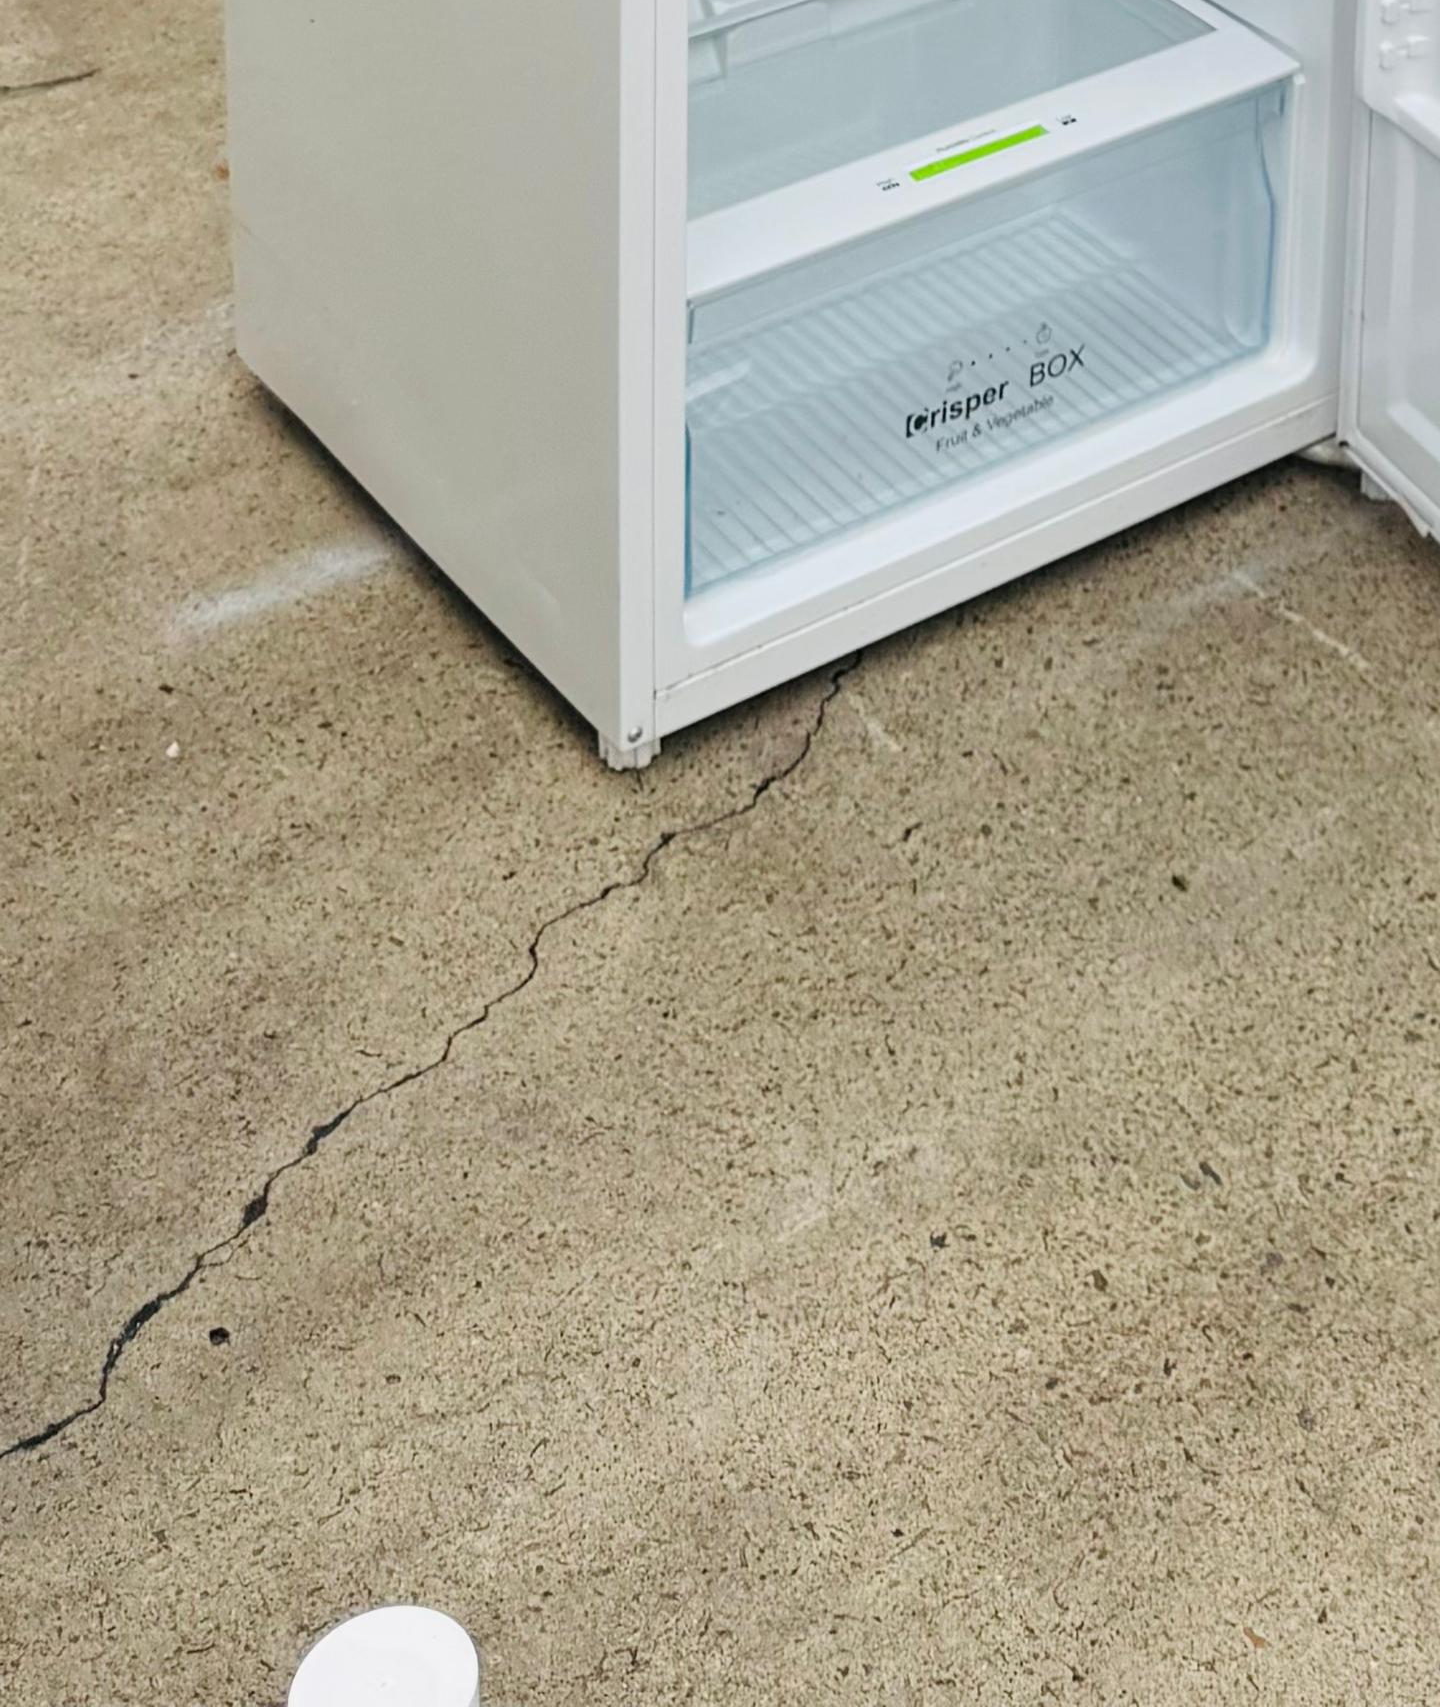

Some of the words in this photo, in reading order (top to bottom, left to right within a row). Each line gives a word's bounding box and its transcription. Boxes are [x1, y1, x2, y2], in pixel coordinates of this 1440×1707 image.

[1029, 344, 1086, 387] BOX
[936, 430, 969, 453] Fruit
[972, 423, 982, 438] &
